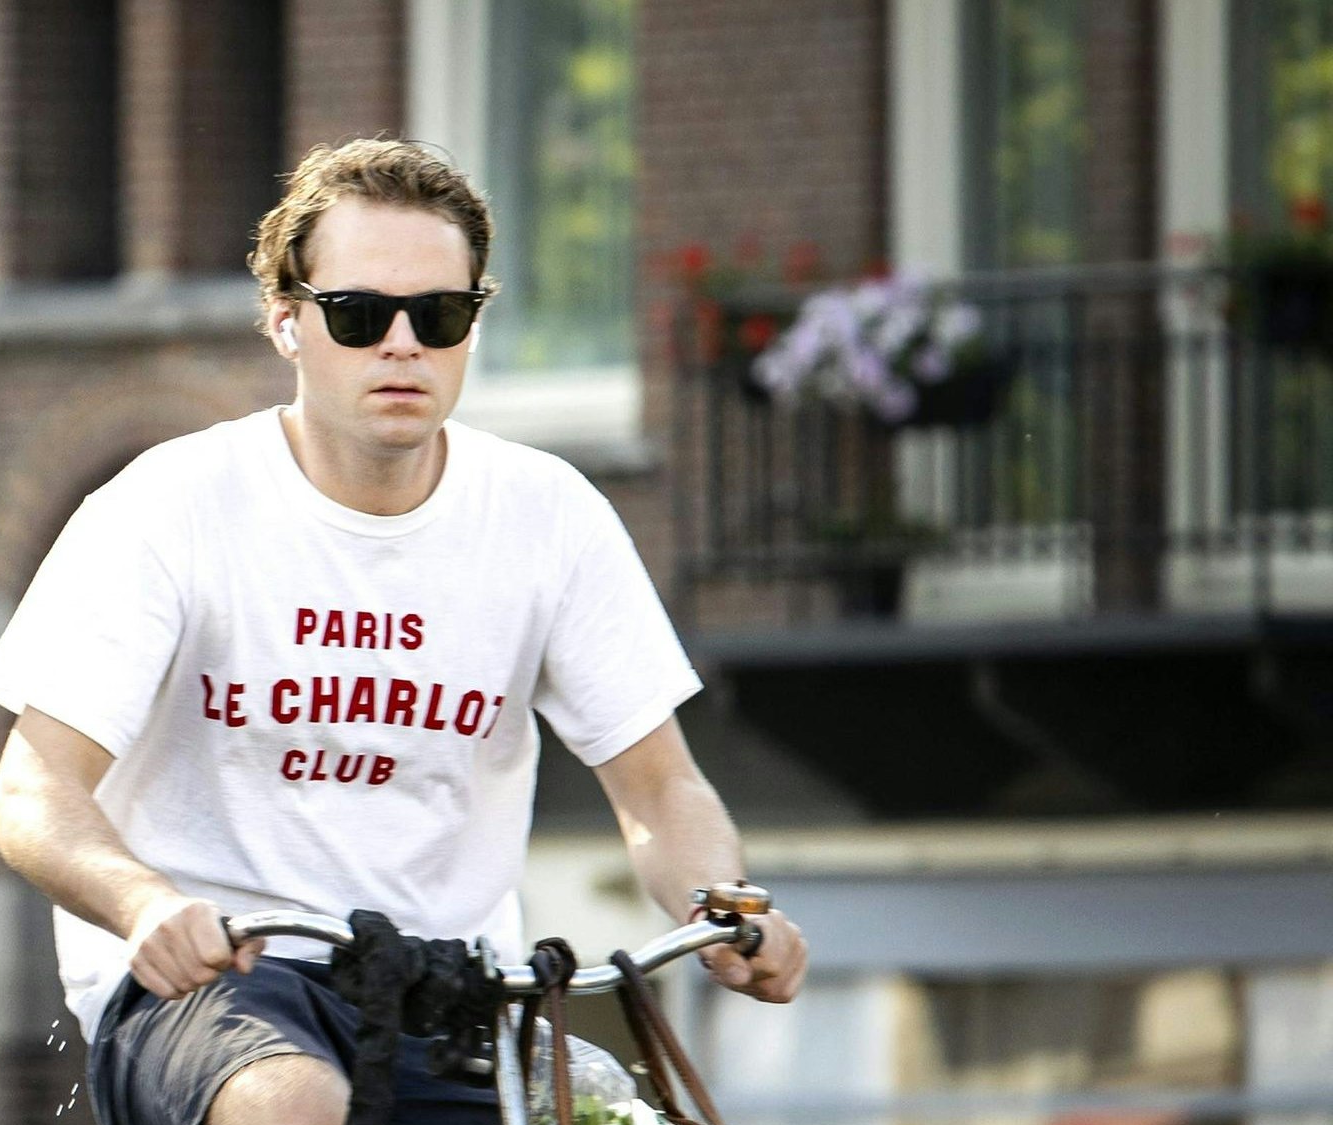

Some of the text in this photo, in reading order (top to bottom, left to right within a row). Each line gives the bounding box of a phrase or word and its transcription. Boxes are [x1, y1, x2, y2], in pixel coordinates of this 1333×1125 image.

[295, 608, 425, 650] PARIS
[201, 674, 248, 727] LE
[280, 749, 397, 786] CLUB
